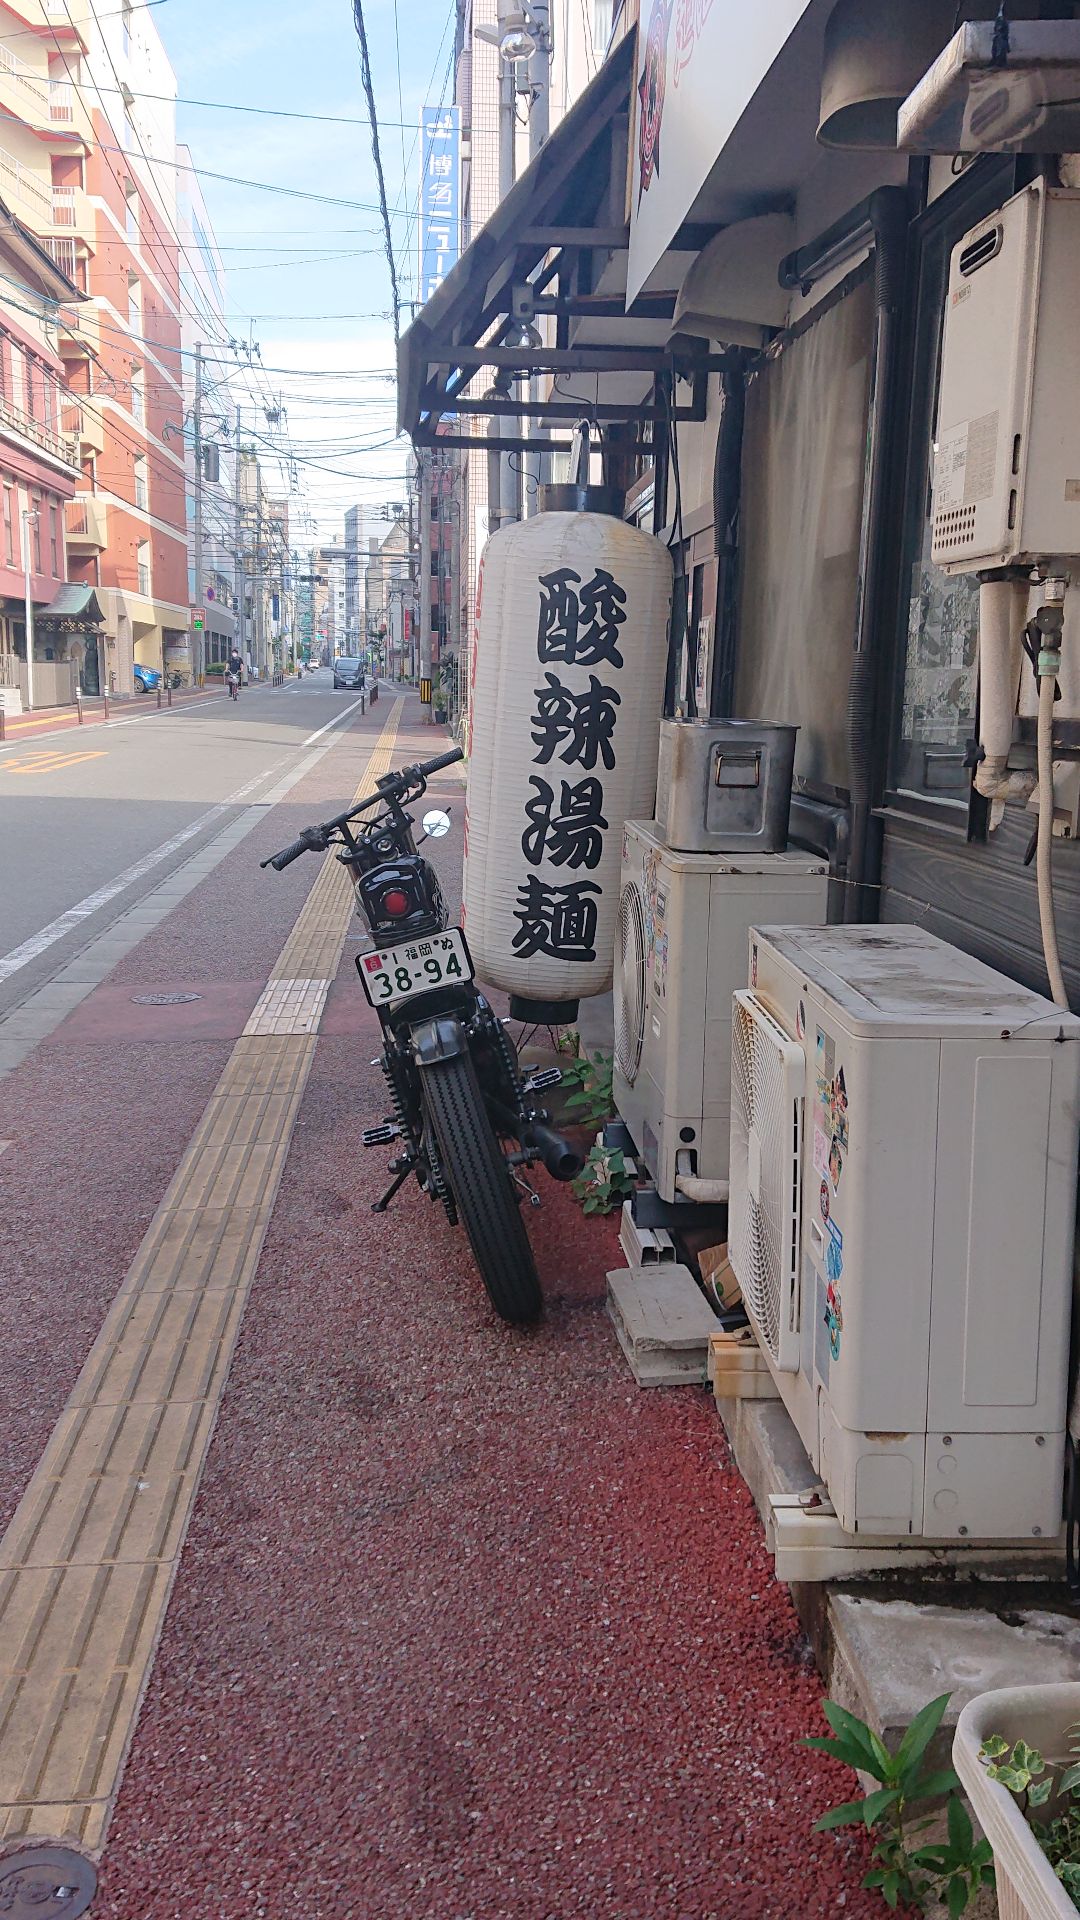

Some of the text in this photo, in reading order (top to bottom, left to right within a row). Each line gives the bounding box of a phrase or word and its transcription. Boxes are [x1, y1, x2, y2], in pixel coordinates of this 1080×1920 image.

[511, 567, 628, 963] 酸辣湯麺
[404, 942, 432, 960] 福岡
[441, 937, 454, 950] ぬ
[373, 952, 462, 998] 38-94
